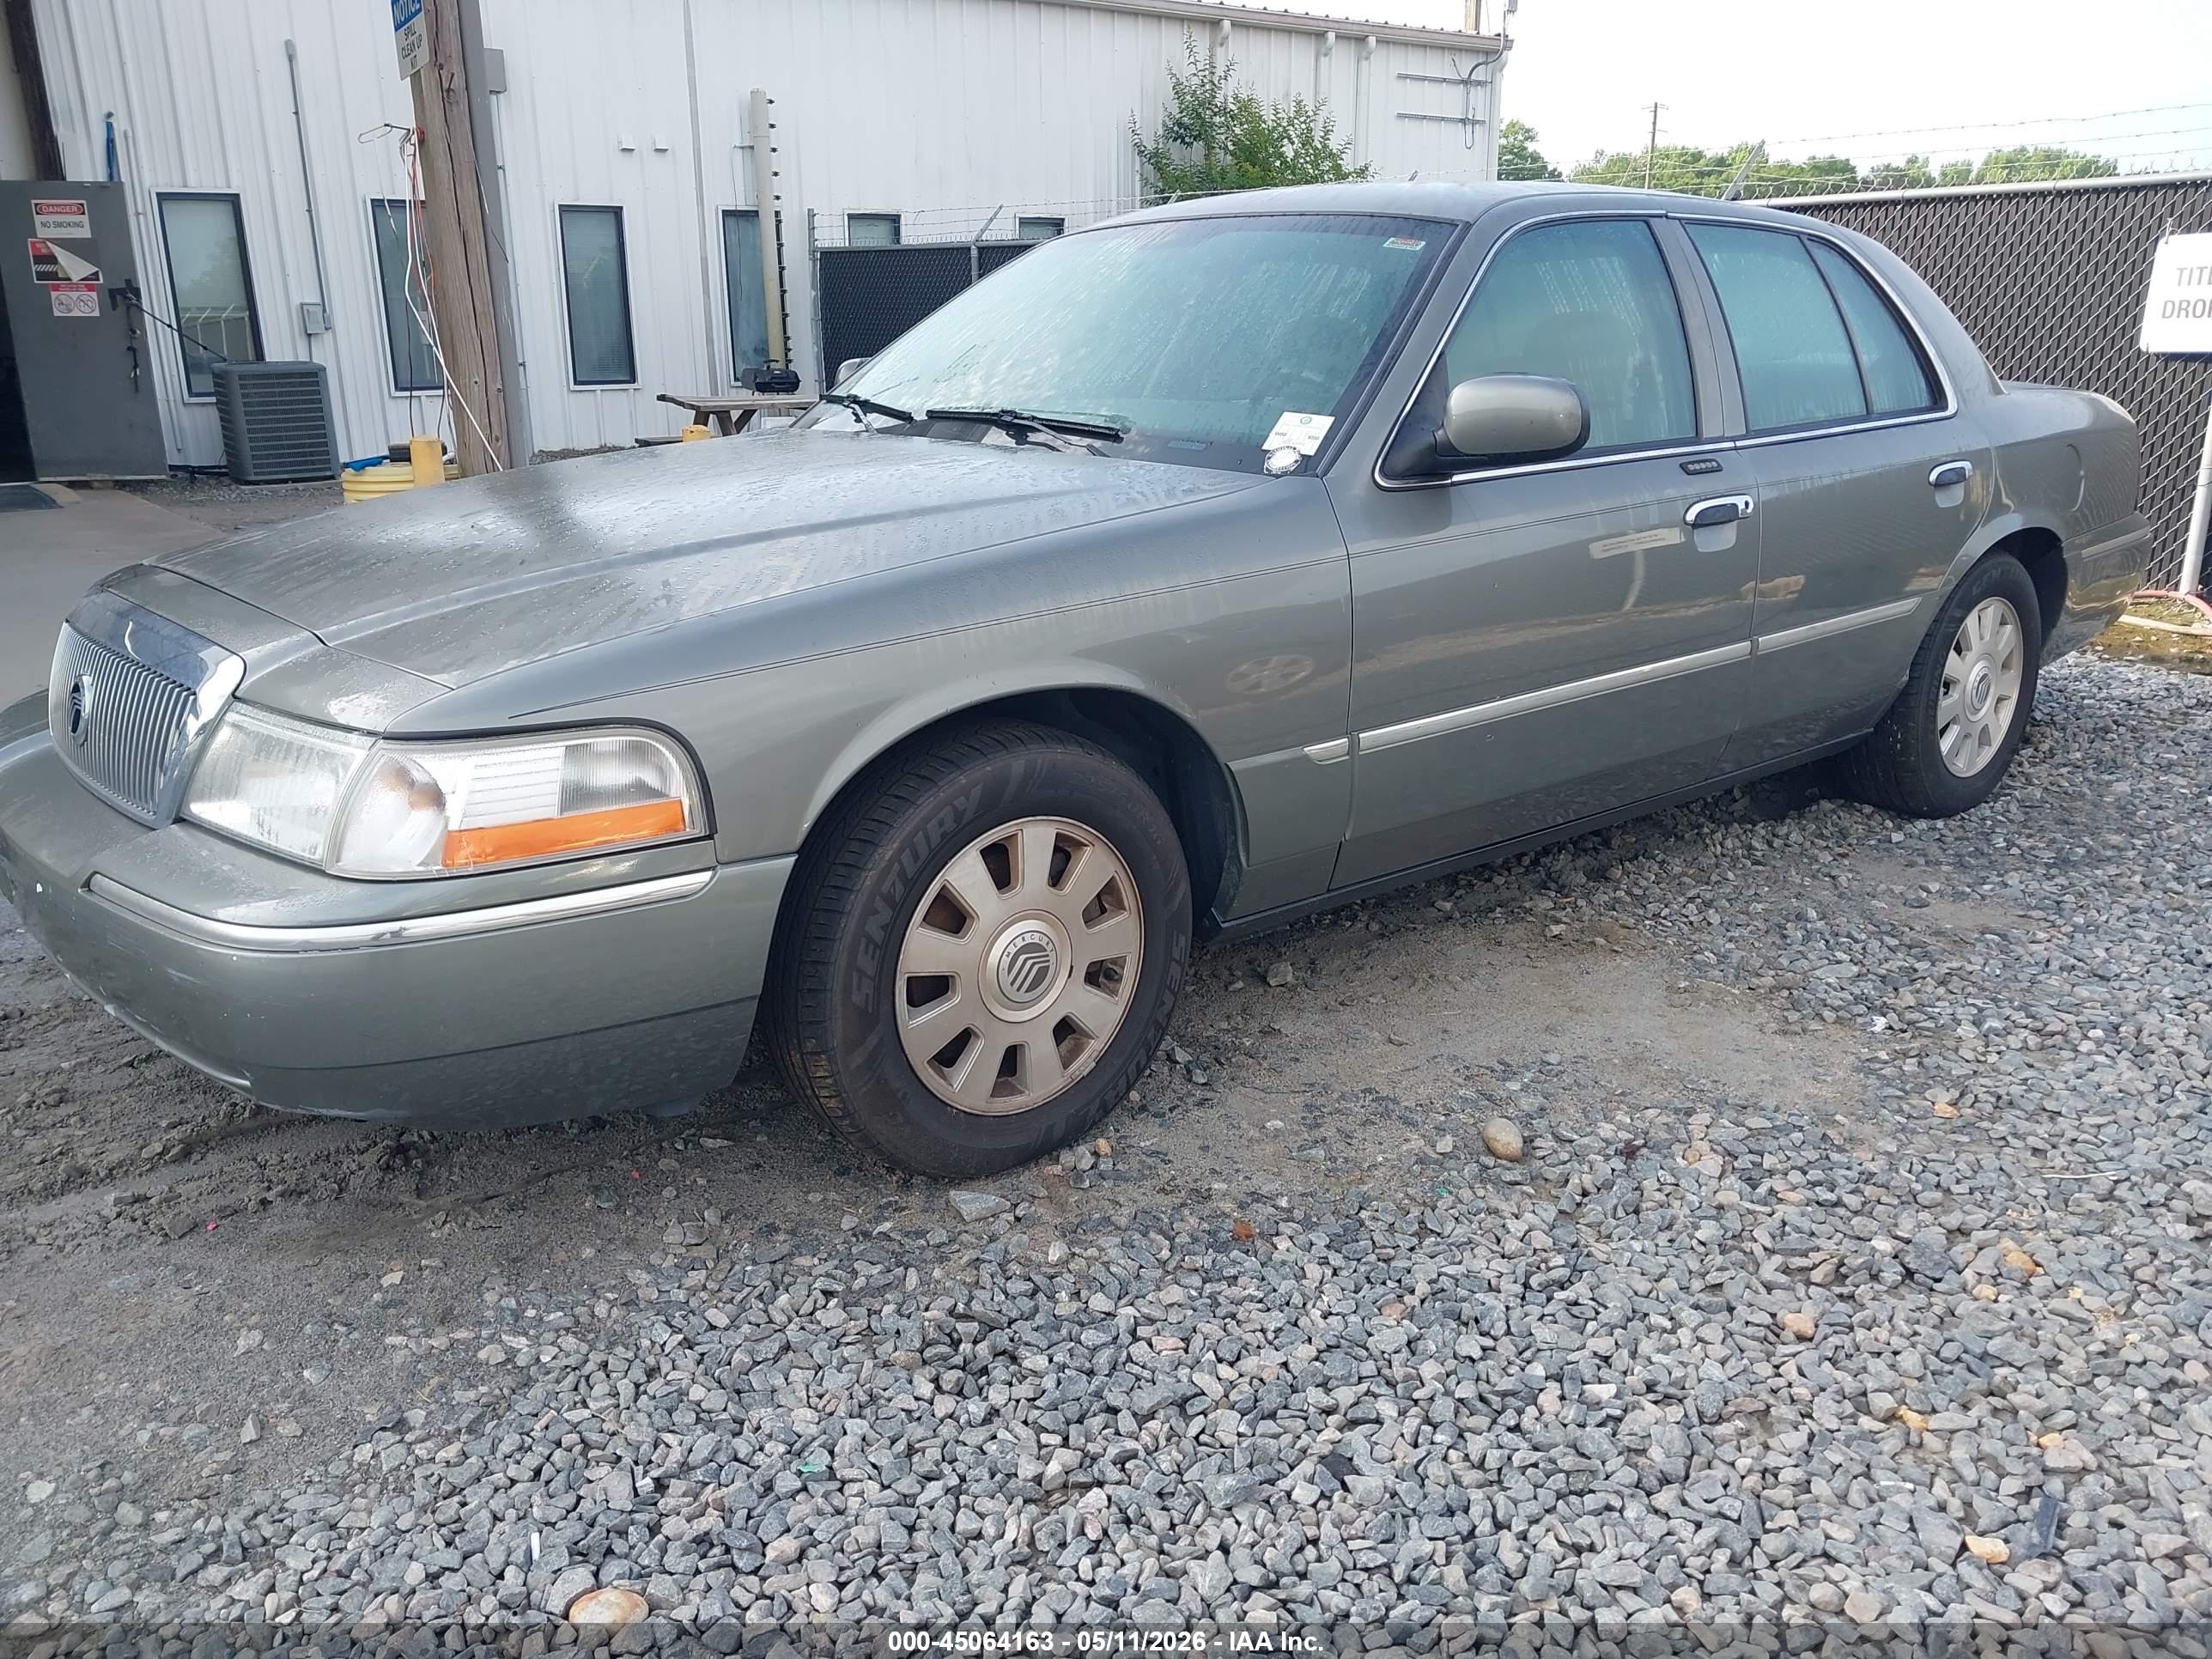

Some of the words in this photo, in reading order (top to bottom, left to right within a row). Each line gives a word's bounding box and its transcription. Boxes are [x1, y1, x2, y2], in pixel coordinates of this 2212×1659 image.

[404, 21, 417, 41] SPILL
[401, 40, 416, 60] CLEAN
[416, 33, 422, 50] UP
[410, 54, 419, 70] KIT
[40, 220, 52, 228] NO
[52, 220, 84, 228] SMOKING
[1004, 933, 1054, 959] MERCURY
